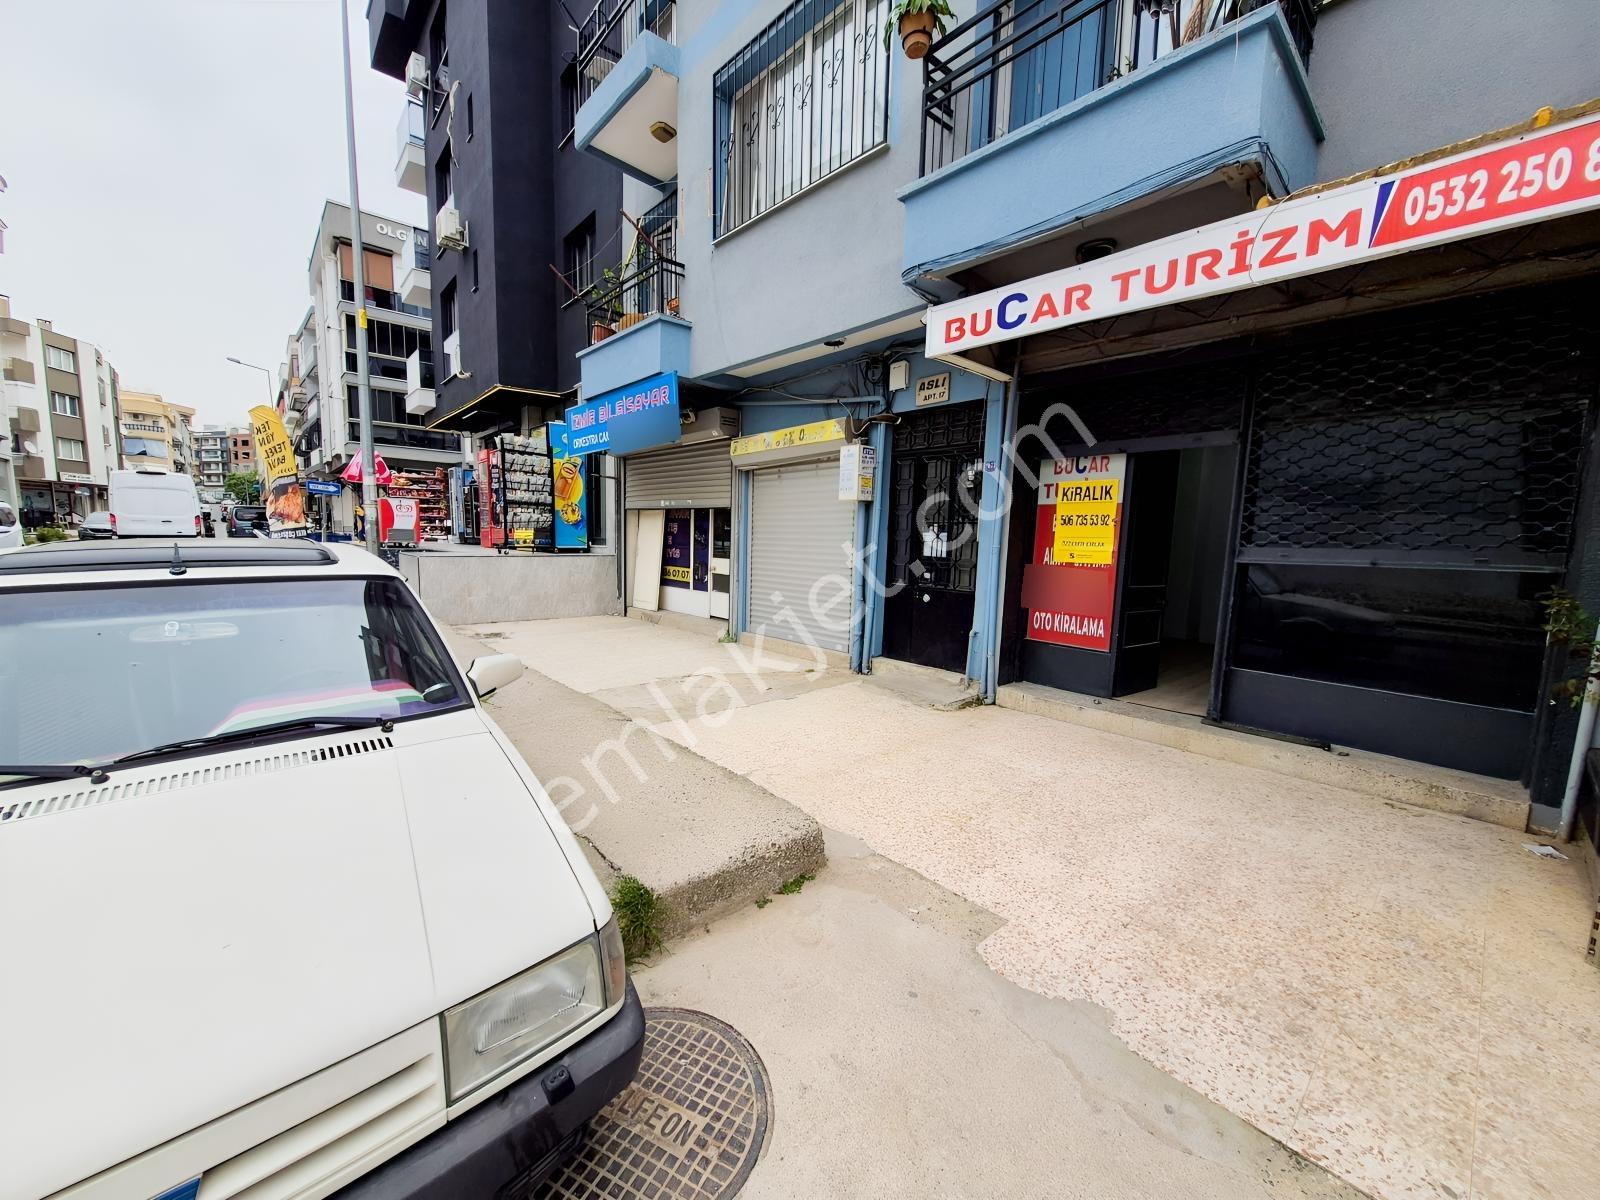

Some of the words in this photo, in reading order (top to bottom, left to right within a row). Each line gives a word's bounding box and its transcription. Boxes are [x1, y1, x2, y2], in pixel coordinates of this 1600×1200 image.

[1404, 169, 1488, 226] 0532
[1497, 147, 1573, 203] 250
[376, 223, 428, 248] OLGN
[944, 283, 1093, 344] BUCAR
[1111, 208, 1362, 302] TURİZM
[918, 376, 947, 393] ASLI
[1053, 455, 1111, 475] BUCAR
[1075, 514, 1088, 525] 735
[1089, 514, 1099, 525] 53
[1100, 514, 1110, 525] 92
[1033, 611, 1052, 631] OTO
[1053, 612, 1104, 638] KİRALAMA
